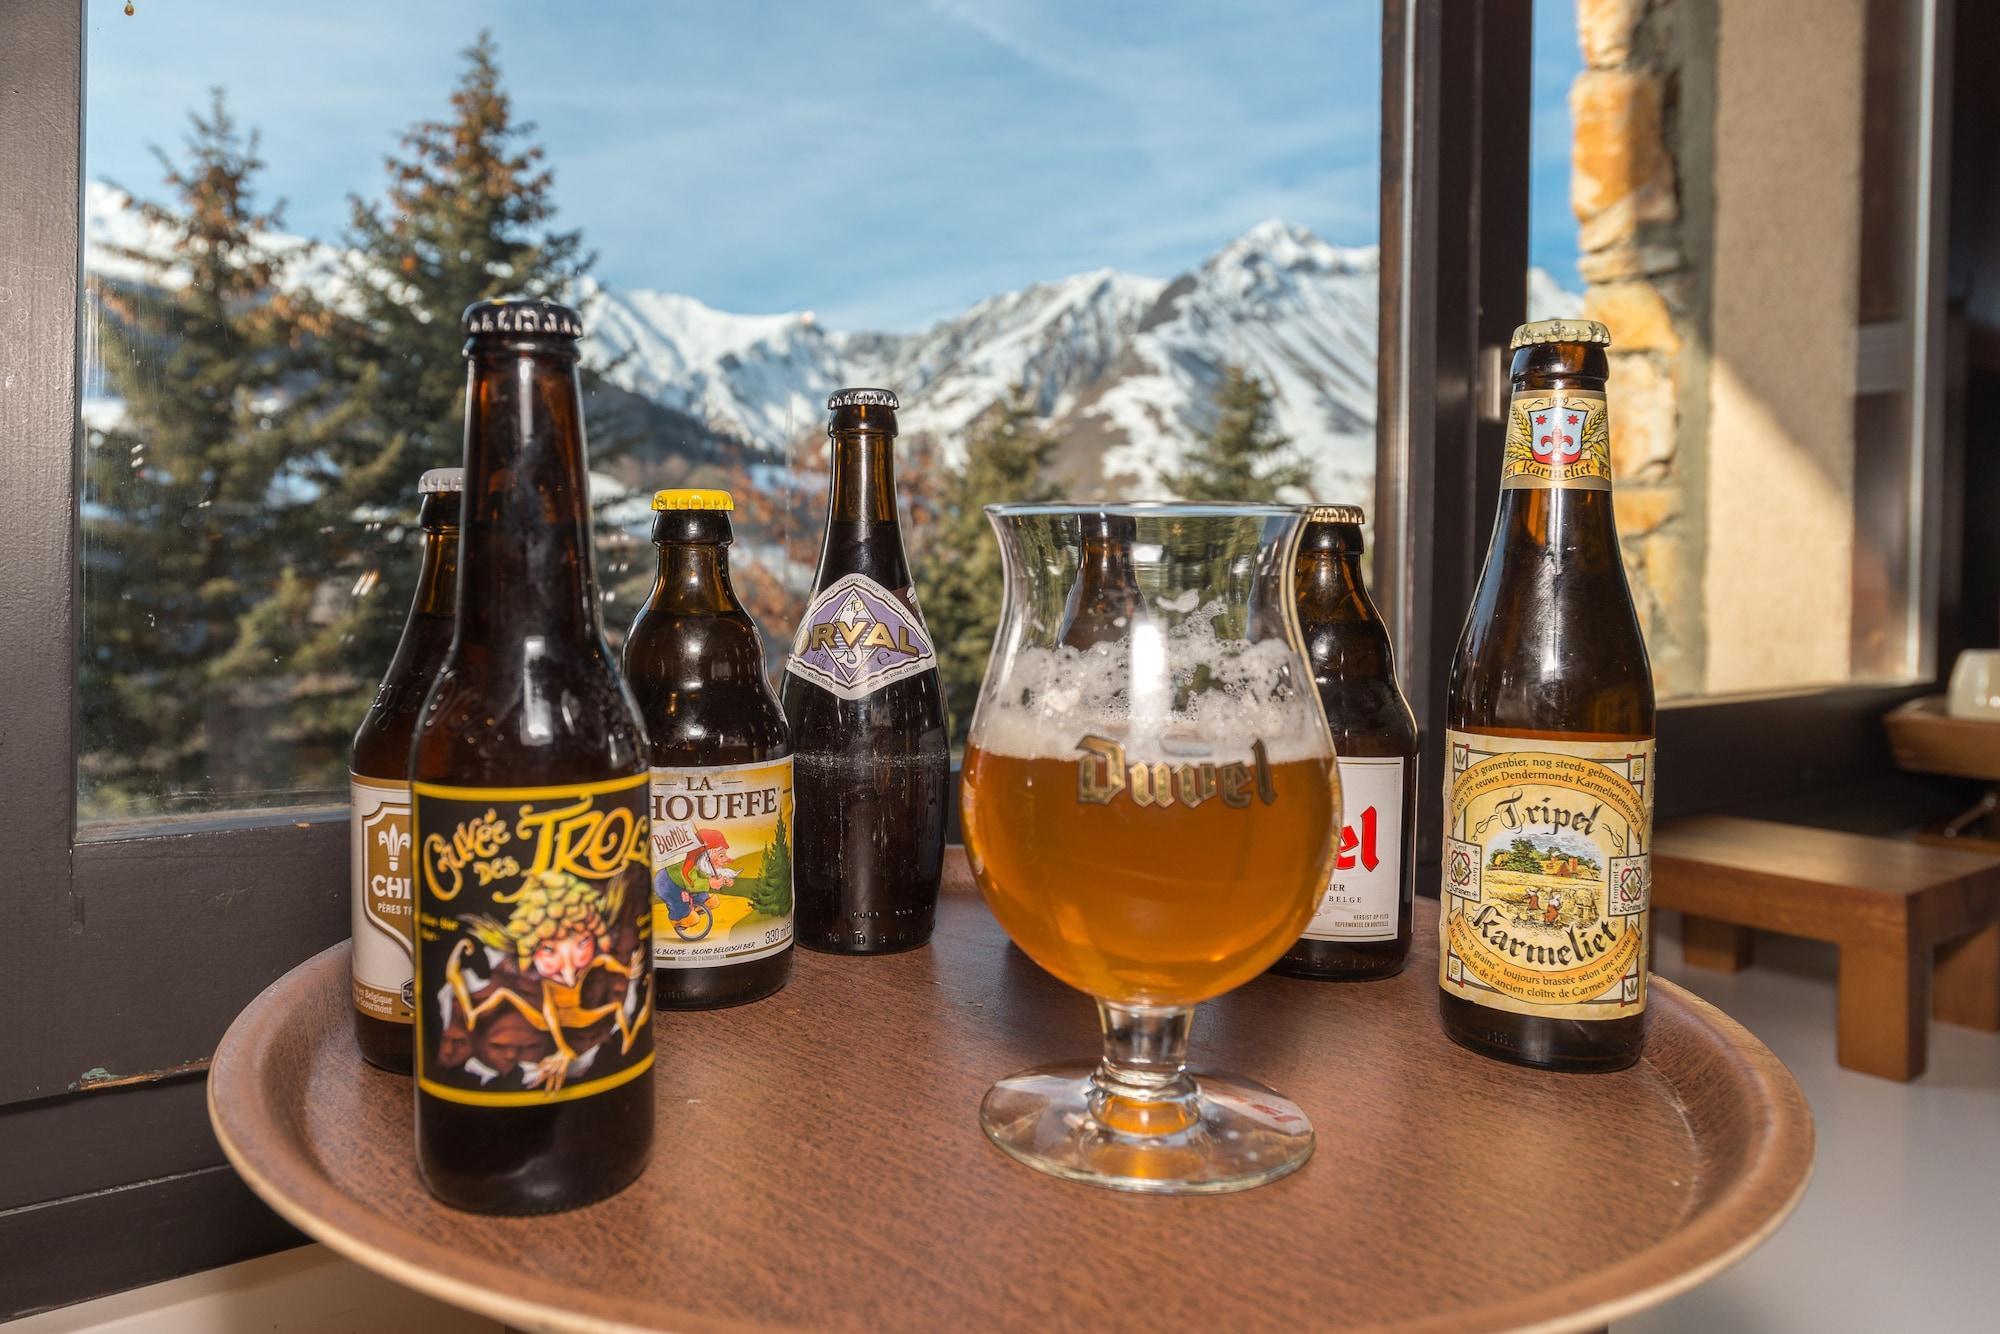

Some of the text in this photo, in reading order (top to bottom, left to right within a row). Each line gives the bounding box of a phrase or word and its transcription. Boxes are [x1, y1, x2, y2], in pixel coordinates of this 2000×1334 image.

[795, 620, 920, 658] ORVAL
[686, 776, 714, 791] LA
[1075, 734, 1277, 808] Duvel
[1474, 769, 1480, 777] 3
[1480, 757, 1529, 776] granenbier,
[1533, 759, 1552, 769] nog
[1556, 760, 1586, 772] steeds
[1587, 768, 1631, 796] gebrouwen
[651, 788, 777, 821] HOUFFE
[1456, 797, 1465, 810] een
[1475, 775, 1500, 789] eeuws
[1501, 769, 1573, 783] Dendermonds
[1576, 776, 1640, 826] Karmelietenrecept
[1494, 788, 1604, 835] Tripel
[1328, 884, 1345, 892] IER
[1328, 895, 1362, 904] BELGE
[377, 903, 402, 915] PÈRES
[662, 948, 687, 956] BLONDE
[691, 948, 712, 956] BLOND
[713, 943, 743, 954] BELGISCH
[743, 941, 756, 950] BIER
[765, 928, 780, 944] 330
[1467, 903, 1617, 966] Karmeliet
[1463, 952, 1479, 971] siècle
[1480, 968, 1489, 978] de
[1490, 975, 1524, 994] l'ancien
[1558, 989, 1570, 998] de
[1572, 981, 1606, 997] Carmes
[1606, 973, 1615, 983] de
[1614, 940, 1639, 975] Termonde
[1503, 968, 1540, 985] toujours
[1543, 976, 1575, 985] brassée
[1578, 968, 1600, 982] selon
[1601, 959, 1615, 972] une
[1614, 936, 1631, 961] recette
